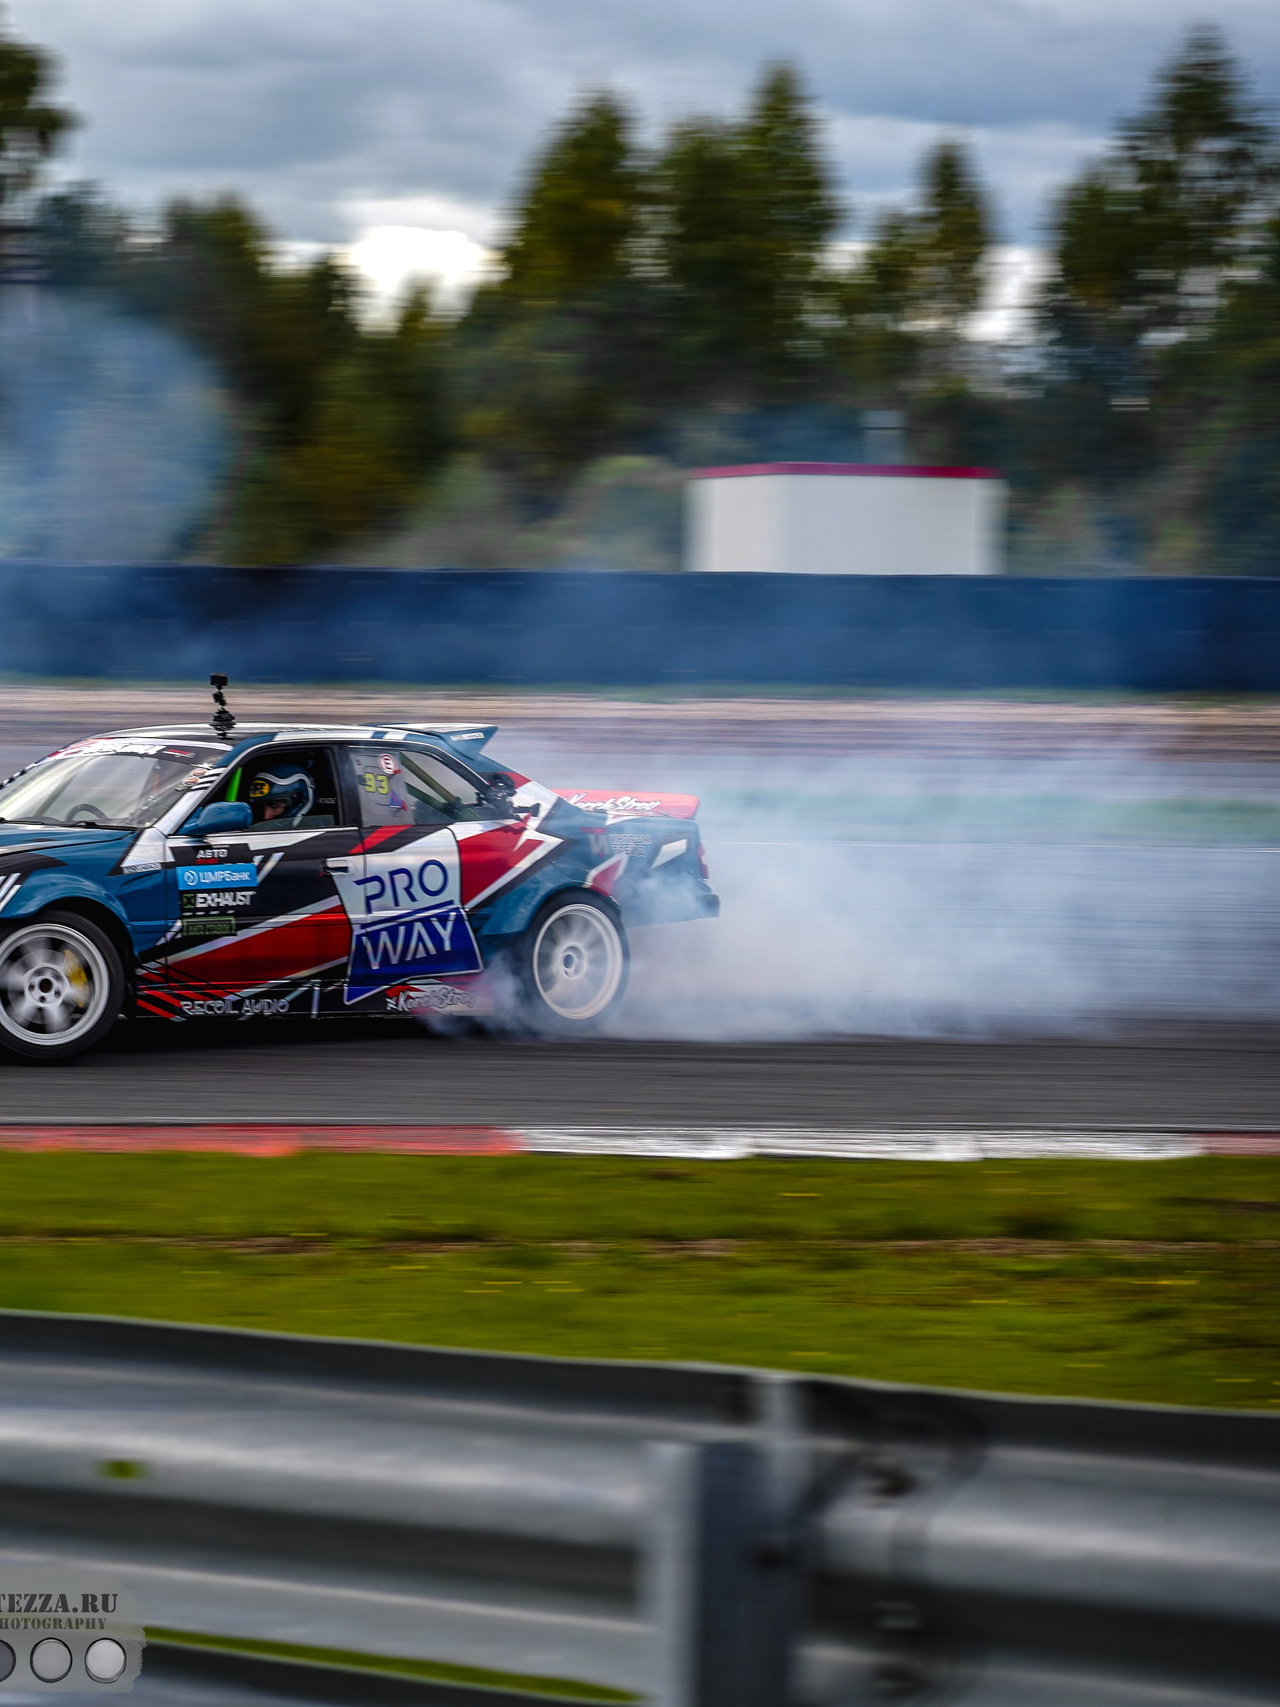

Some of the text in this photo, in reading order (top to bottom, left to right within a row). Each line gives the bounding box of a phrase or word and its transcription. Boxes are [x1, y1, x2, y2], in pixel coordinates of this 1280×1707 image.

[363, 772, 389, 794] 93
[352, 859, 448, 914] PRO
[195, 891, 257, 908] EXHAUST
[361, 912, 457, 970] WAY
[180, 999, 289, 1015] RECOIL AUDIO
